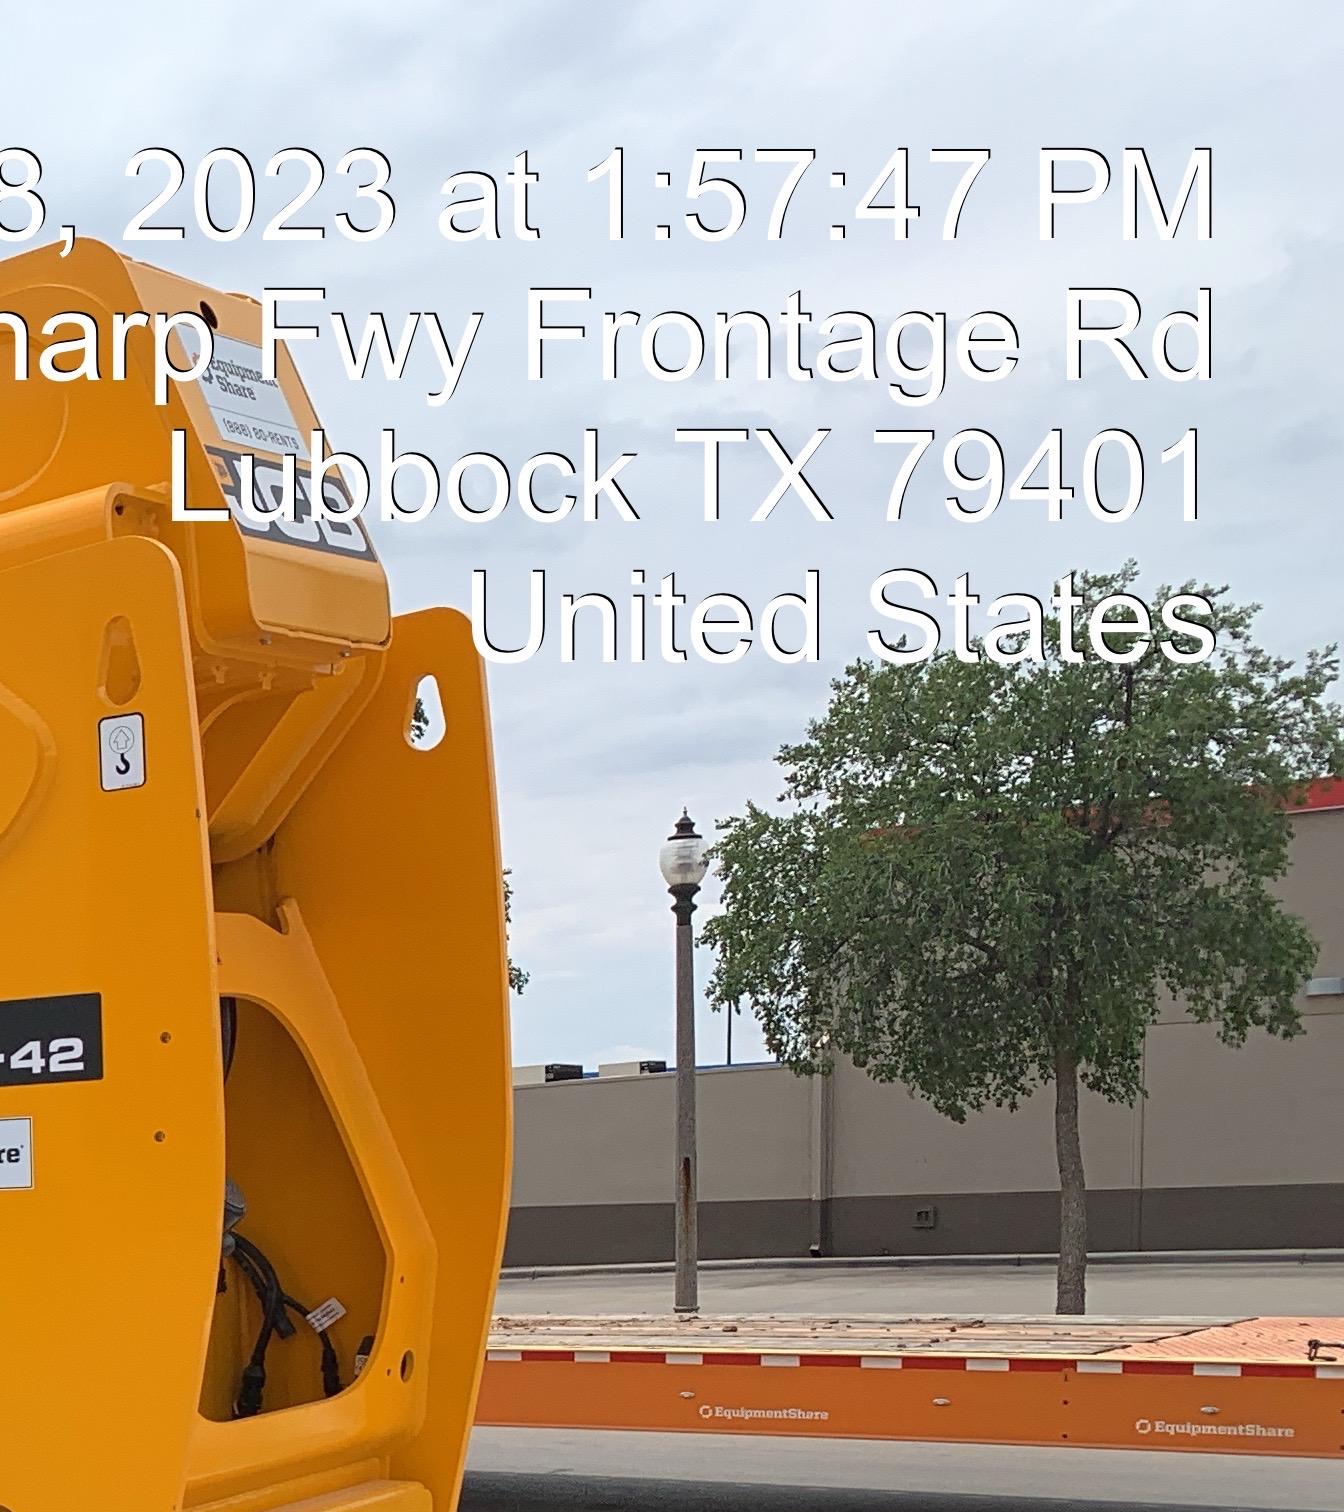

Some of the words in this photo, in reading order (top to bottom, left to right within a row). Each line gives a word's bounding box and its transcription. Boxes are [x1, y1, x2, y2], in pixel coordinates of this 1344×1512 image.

[211, 358, 278, 388] Equipme
[215, 374, 256, 401] Share
[714, 1406, 829, 1421] EquipmentShare
[1154, 1420, 1295, 1438] EquipmentShare
